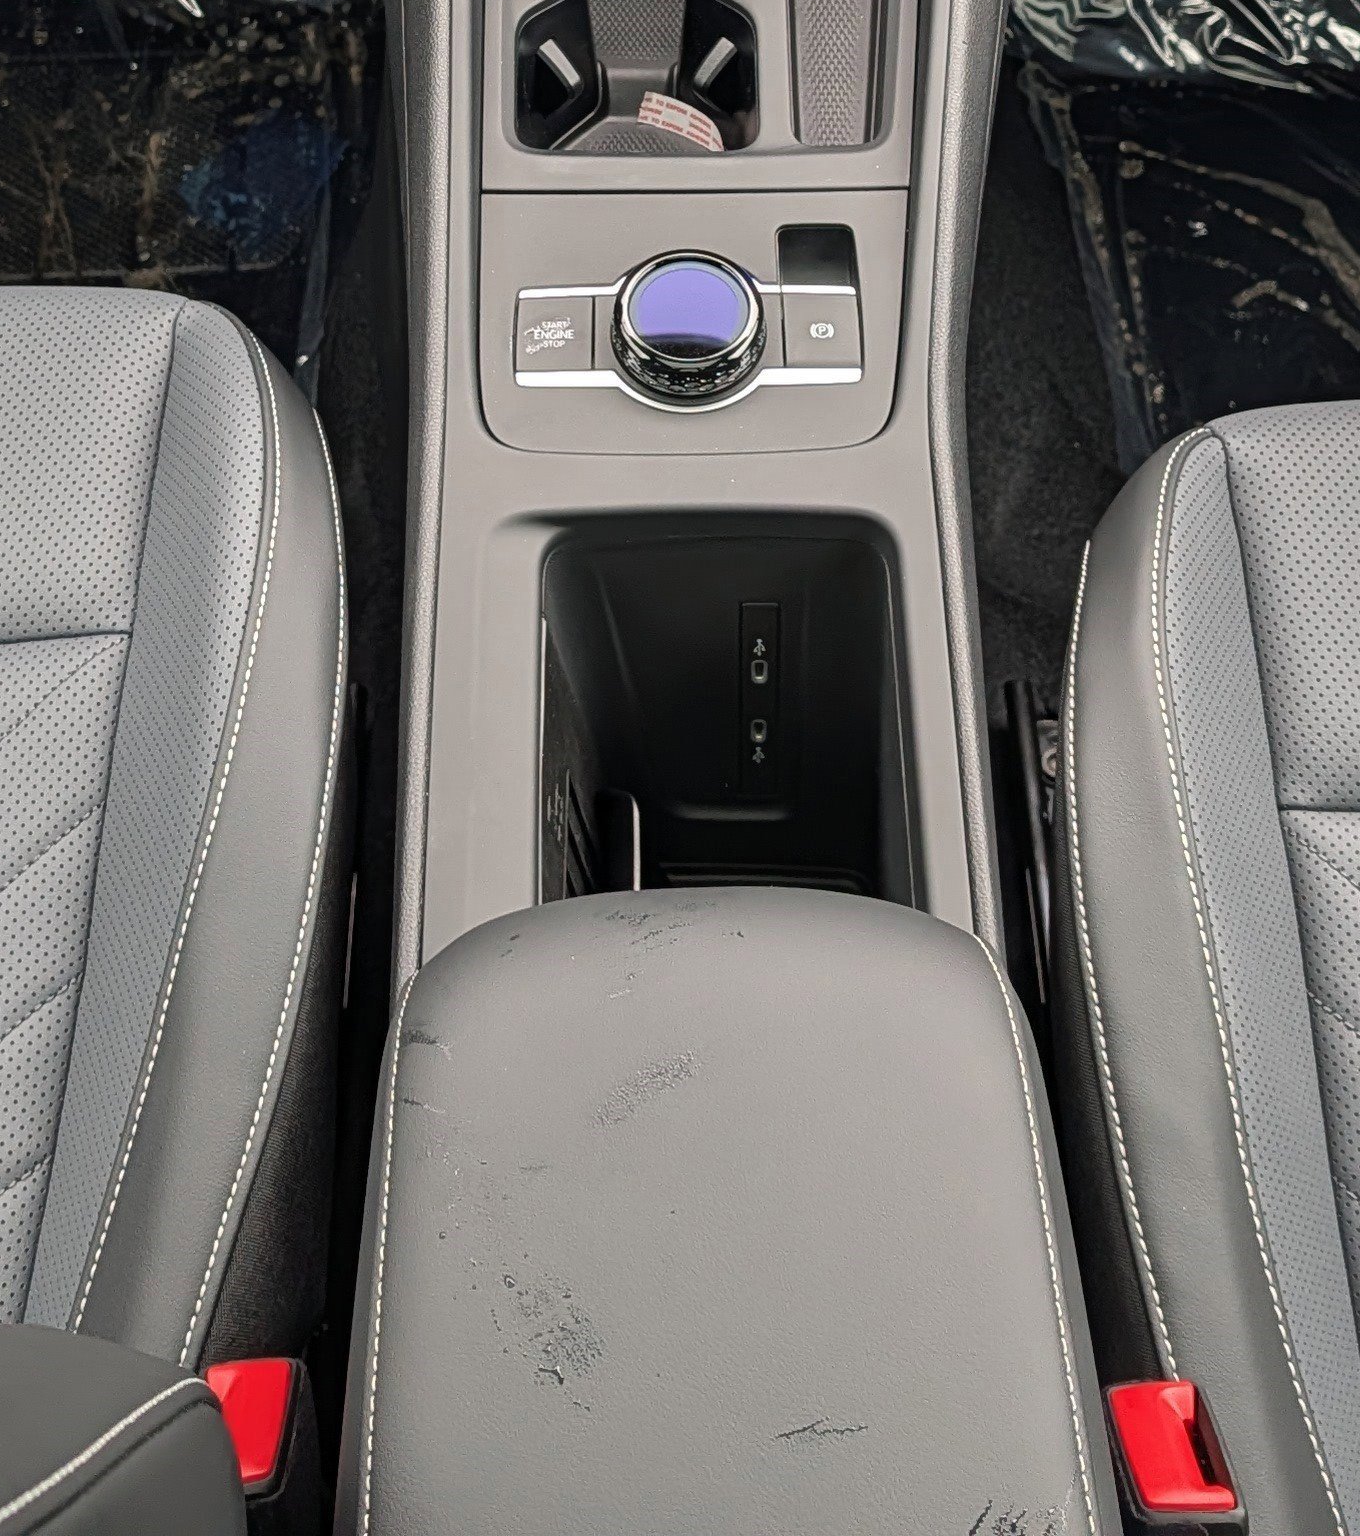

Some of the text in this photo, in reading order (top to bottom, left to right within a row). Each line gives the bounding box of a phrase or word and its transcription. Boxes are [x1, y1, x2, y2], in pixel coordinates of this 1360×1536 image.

[541, 321, 569, 330] START
[533, 329, 575, 340] ENGINE
[543, 340, 566, 348] STOP
